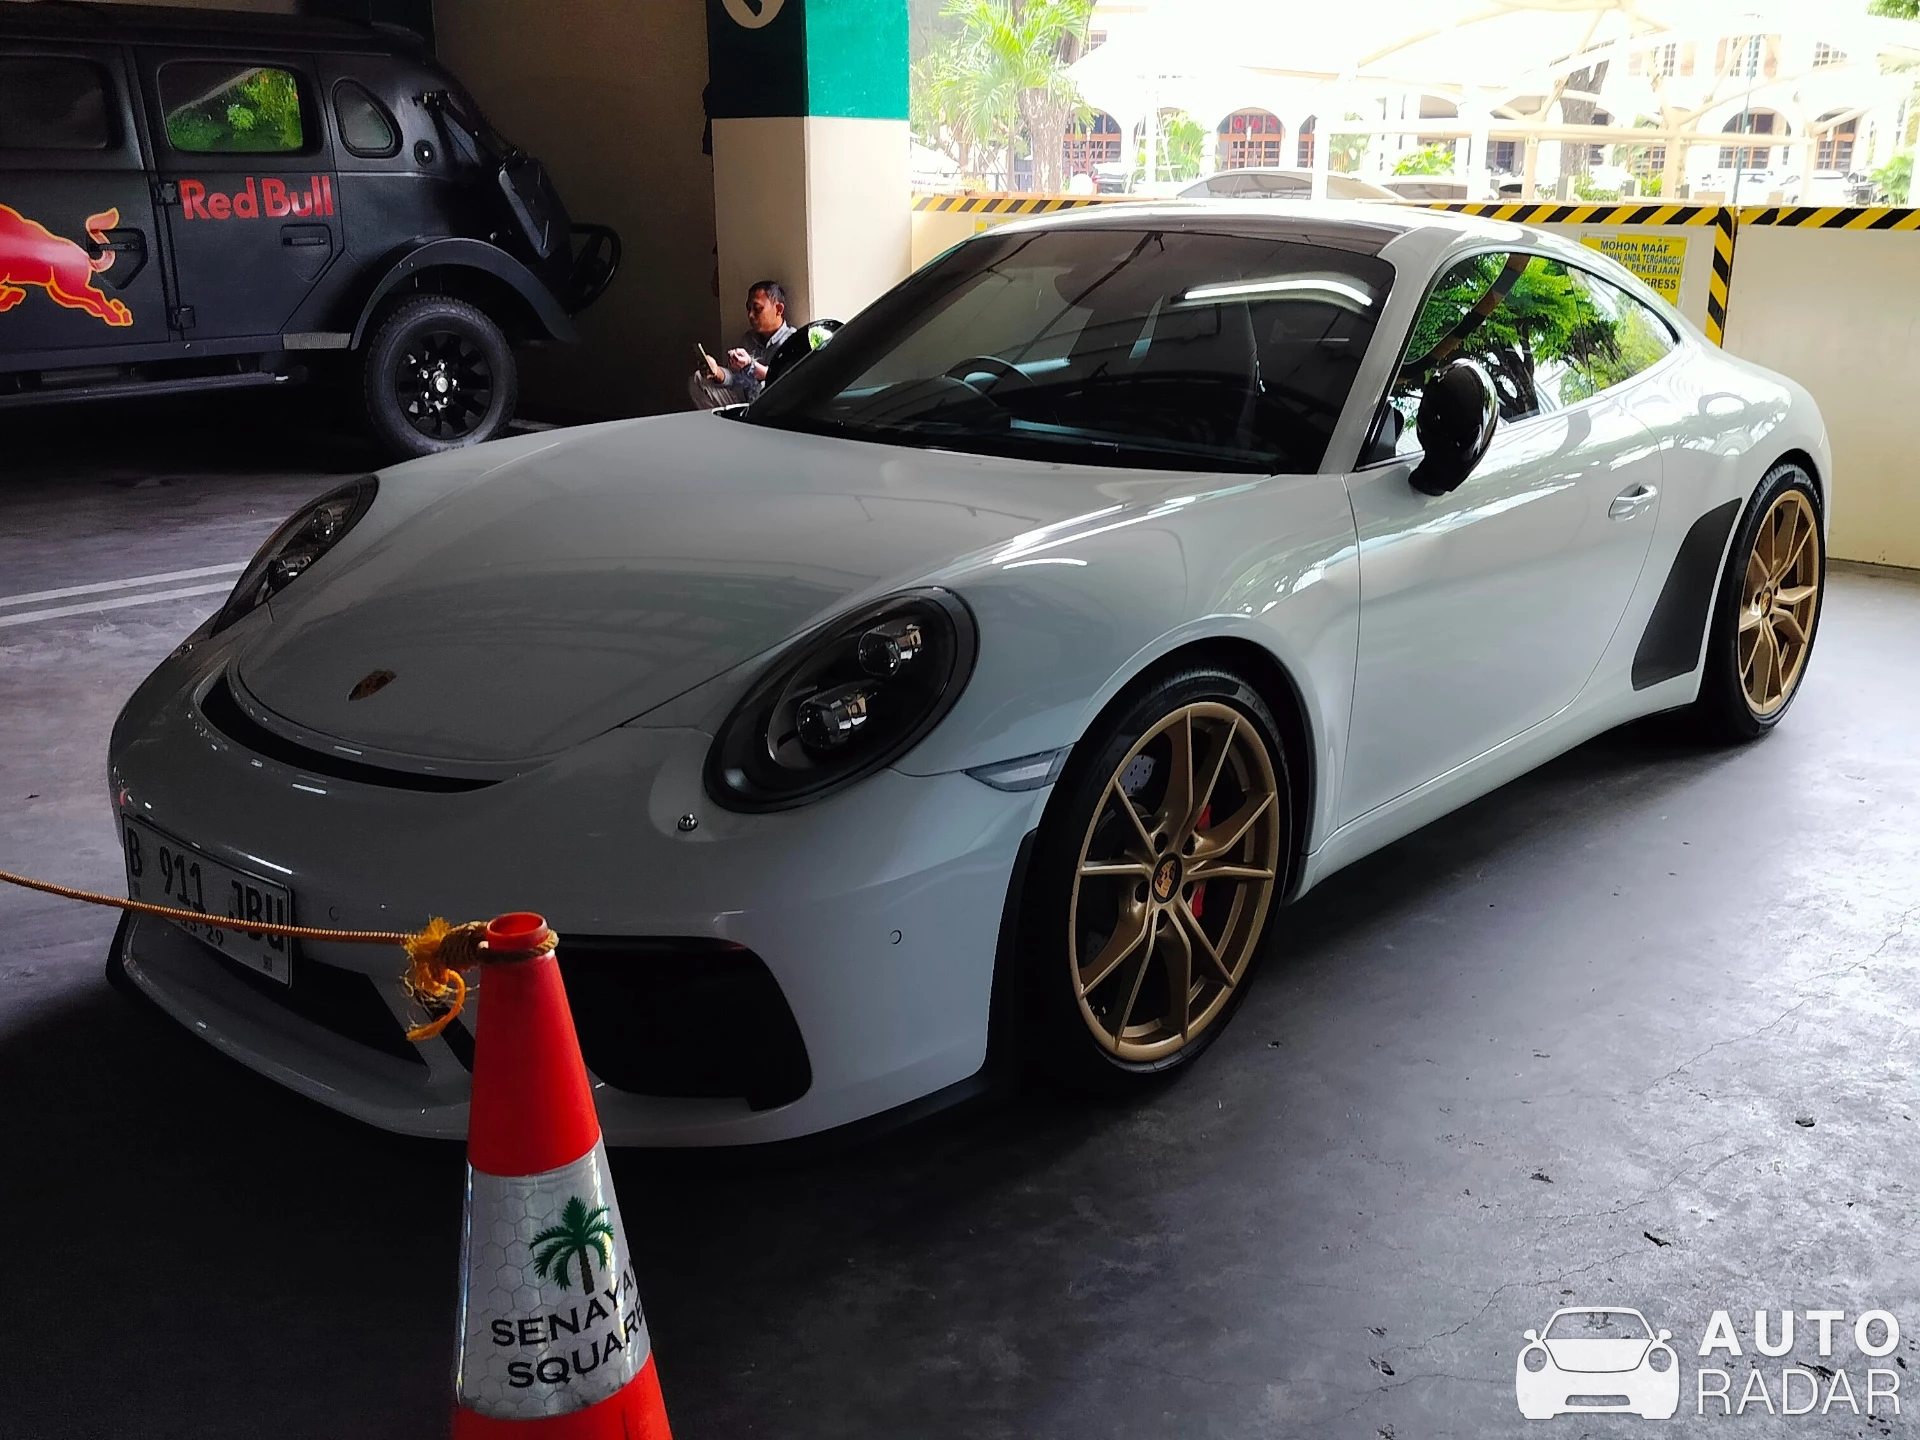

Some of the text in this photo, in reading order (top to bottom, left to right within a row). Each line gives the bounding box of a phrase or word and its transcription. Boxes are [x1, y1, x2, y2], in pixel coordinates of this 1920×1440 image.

[180, 175, 334, 220] Red Bull
[1600, 240, 1670, 253] MOHON MAAF
[1623, 252, 1640, 263] ANDA
[1643, 254, 1682, 265] TERGANGGU
[1631, 263, 1680, 275] PEKERJAAN
[1638, 276, 1677, 290] GRESS
[127, 827, 284, 952] B 911 JBU
[507, 1292, 644, 1388] SQUARE
